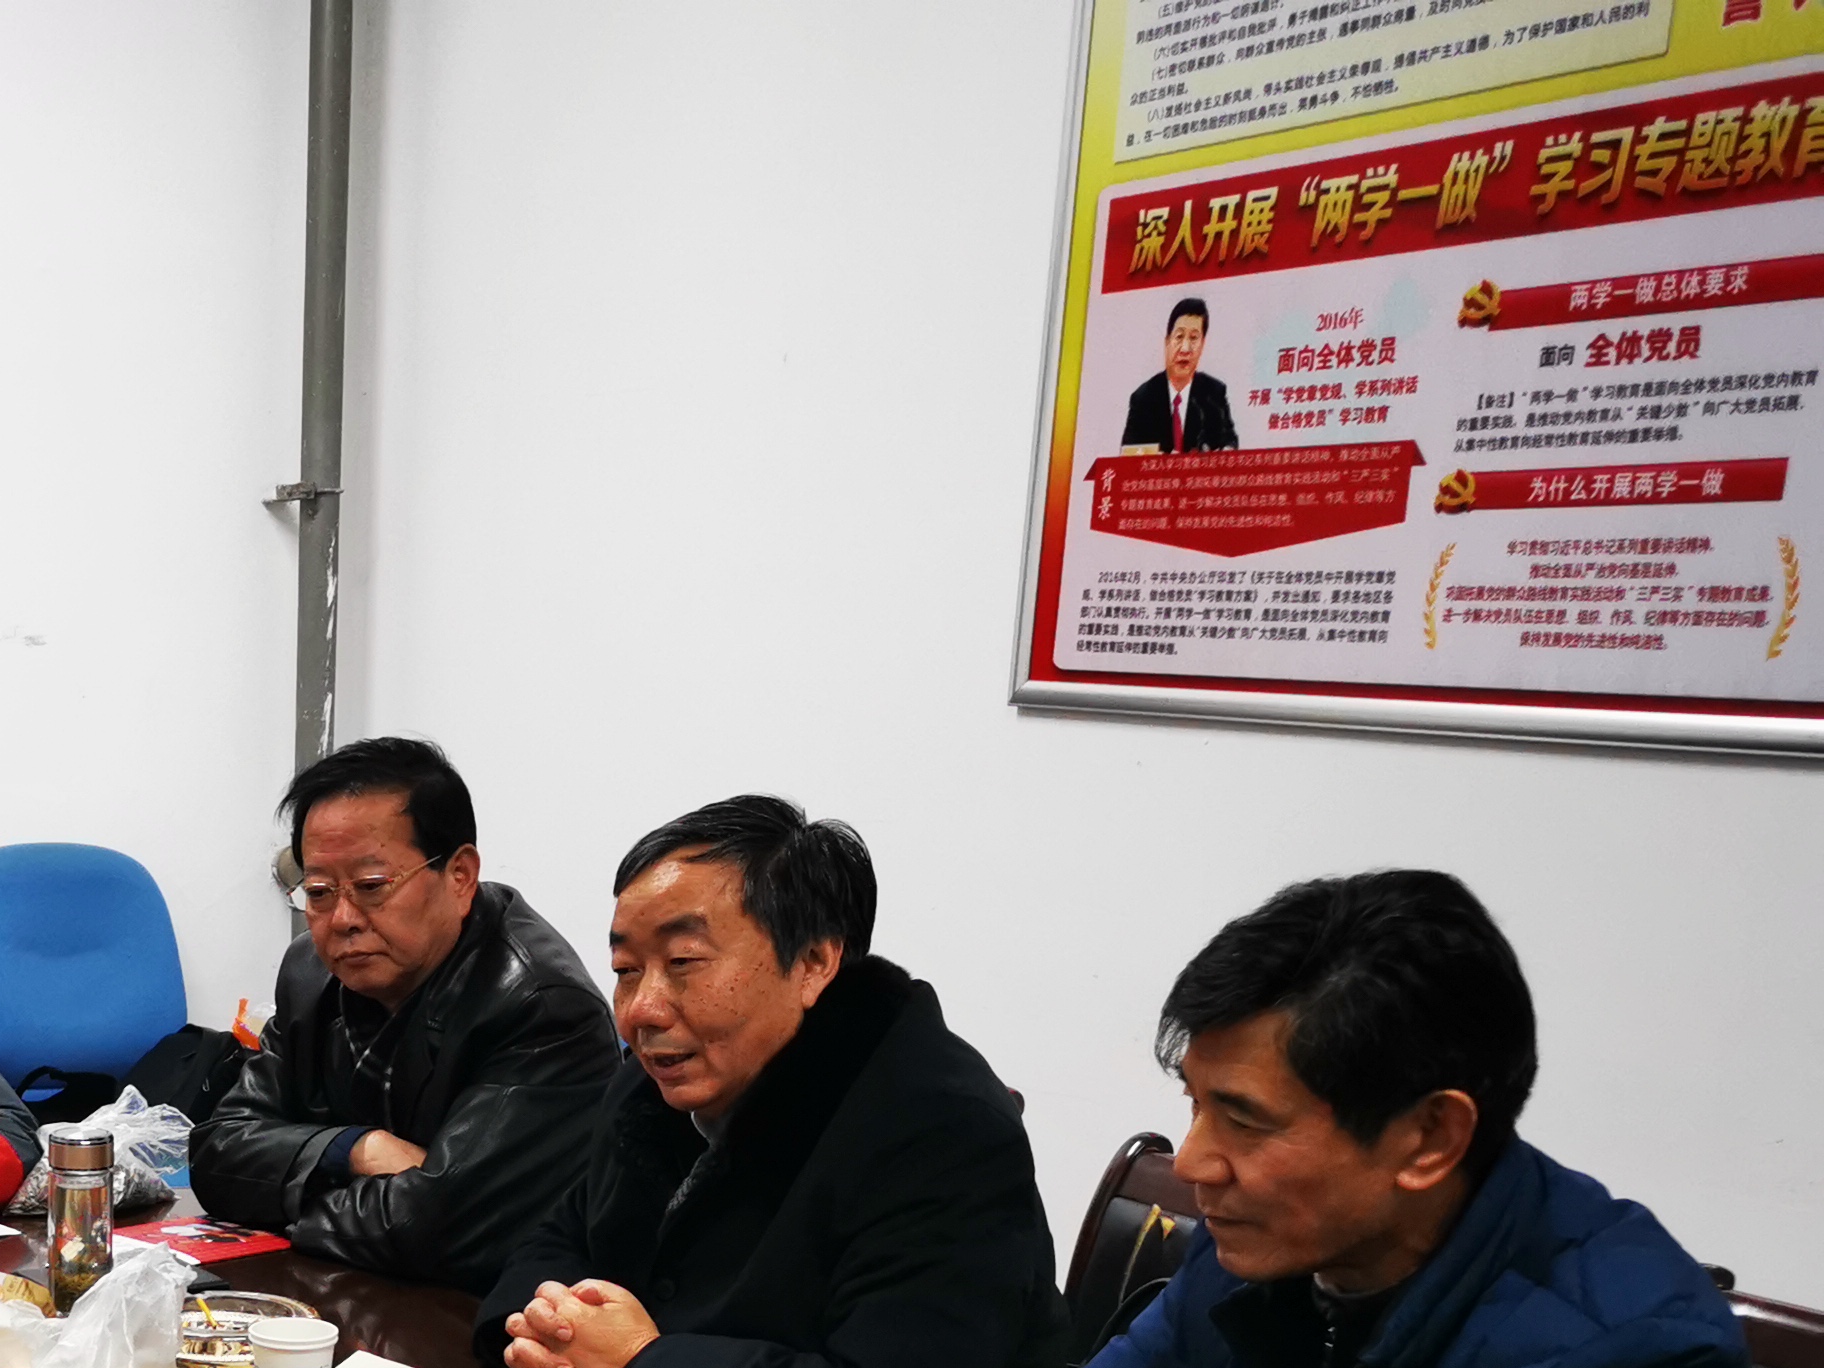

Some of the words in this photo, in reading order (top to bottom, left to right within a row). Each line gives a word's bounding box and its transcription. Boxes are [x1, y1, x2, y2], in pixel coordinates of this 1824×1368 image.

[1569, 265, 1750, 312] 两学一做总体要求
[1315, 305, 1365, 332] 2016年
[1277, 336, 1397, 376] 面向全体党员
[1538, 344, 1576, 368] 面向
[1584, 325, 1703, 368] 全体党员
[1097, 468, 1117, 520] 背景
[1527, 468, 1725, 502] 为什么开展两学一做
